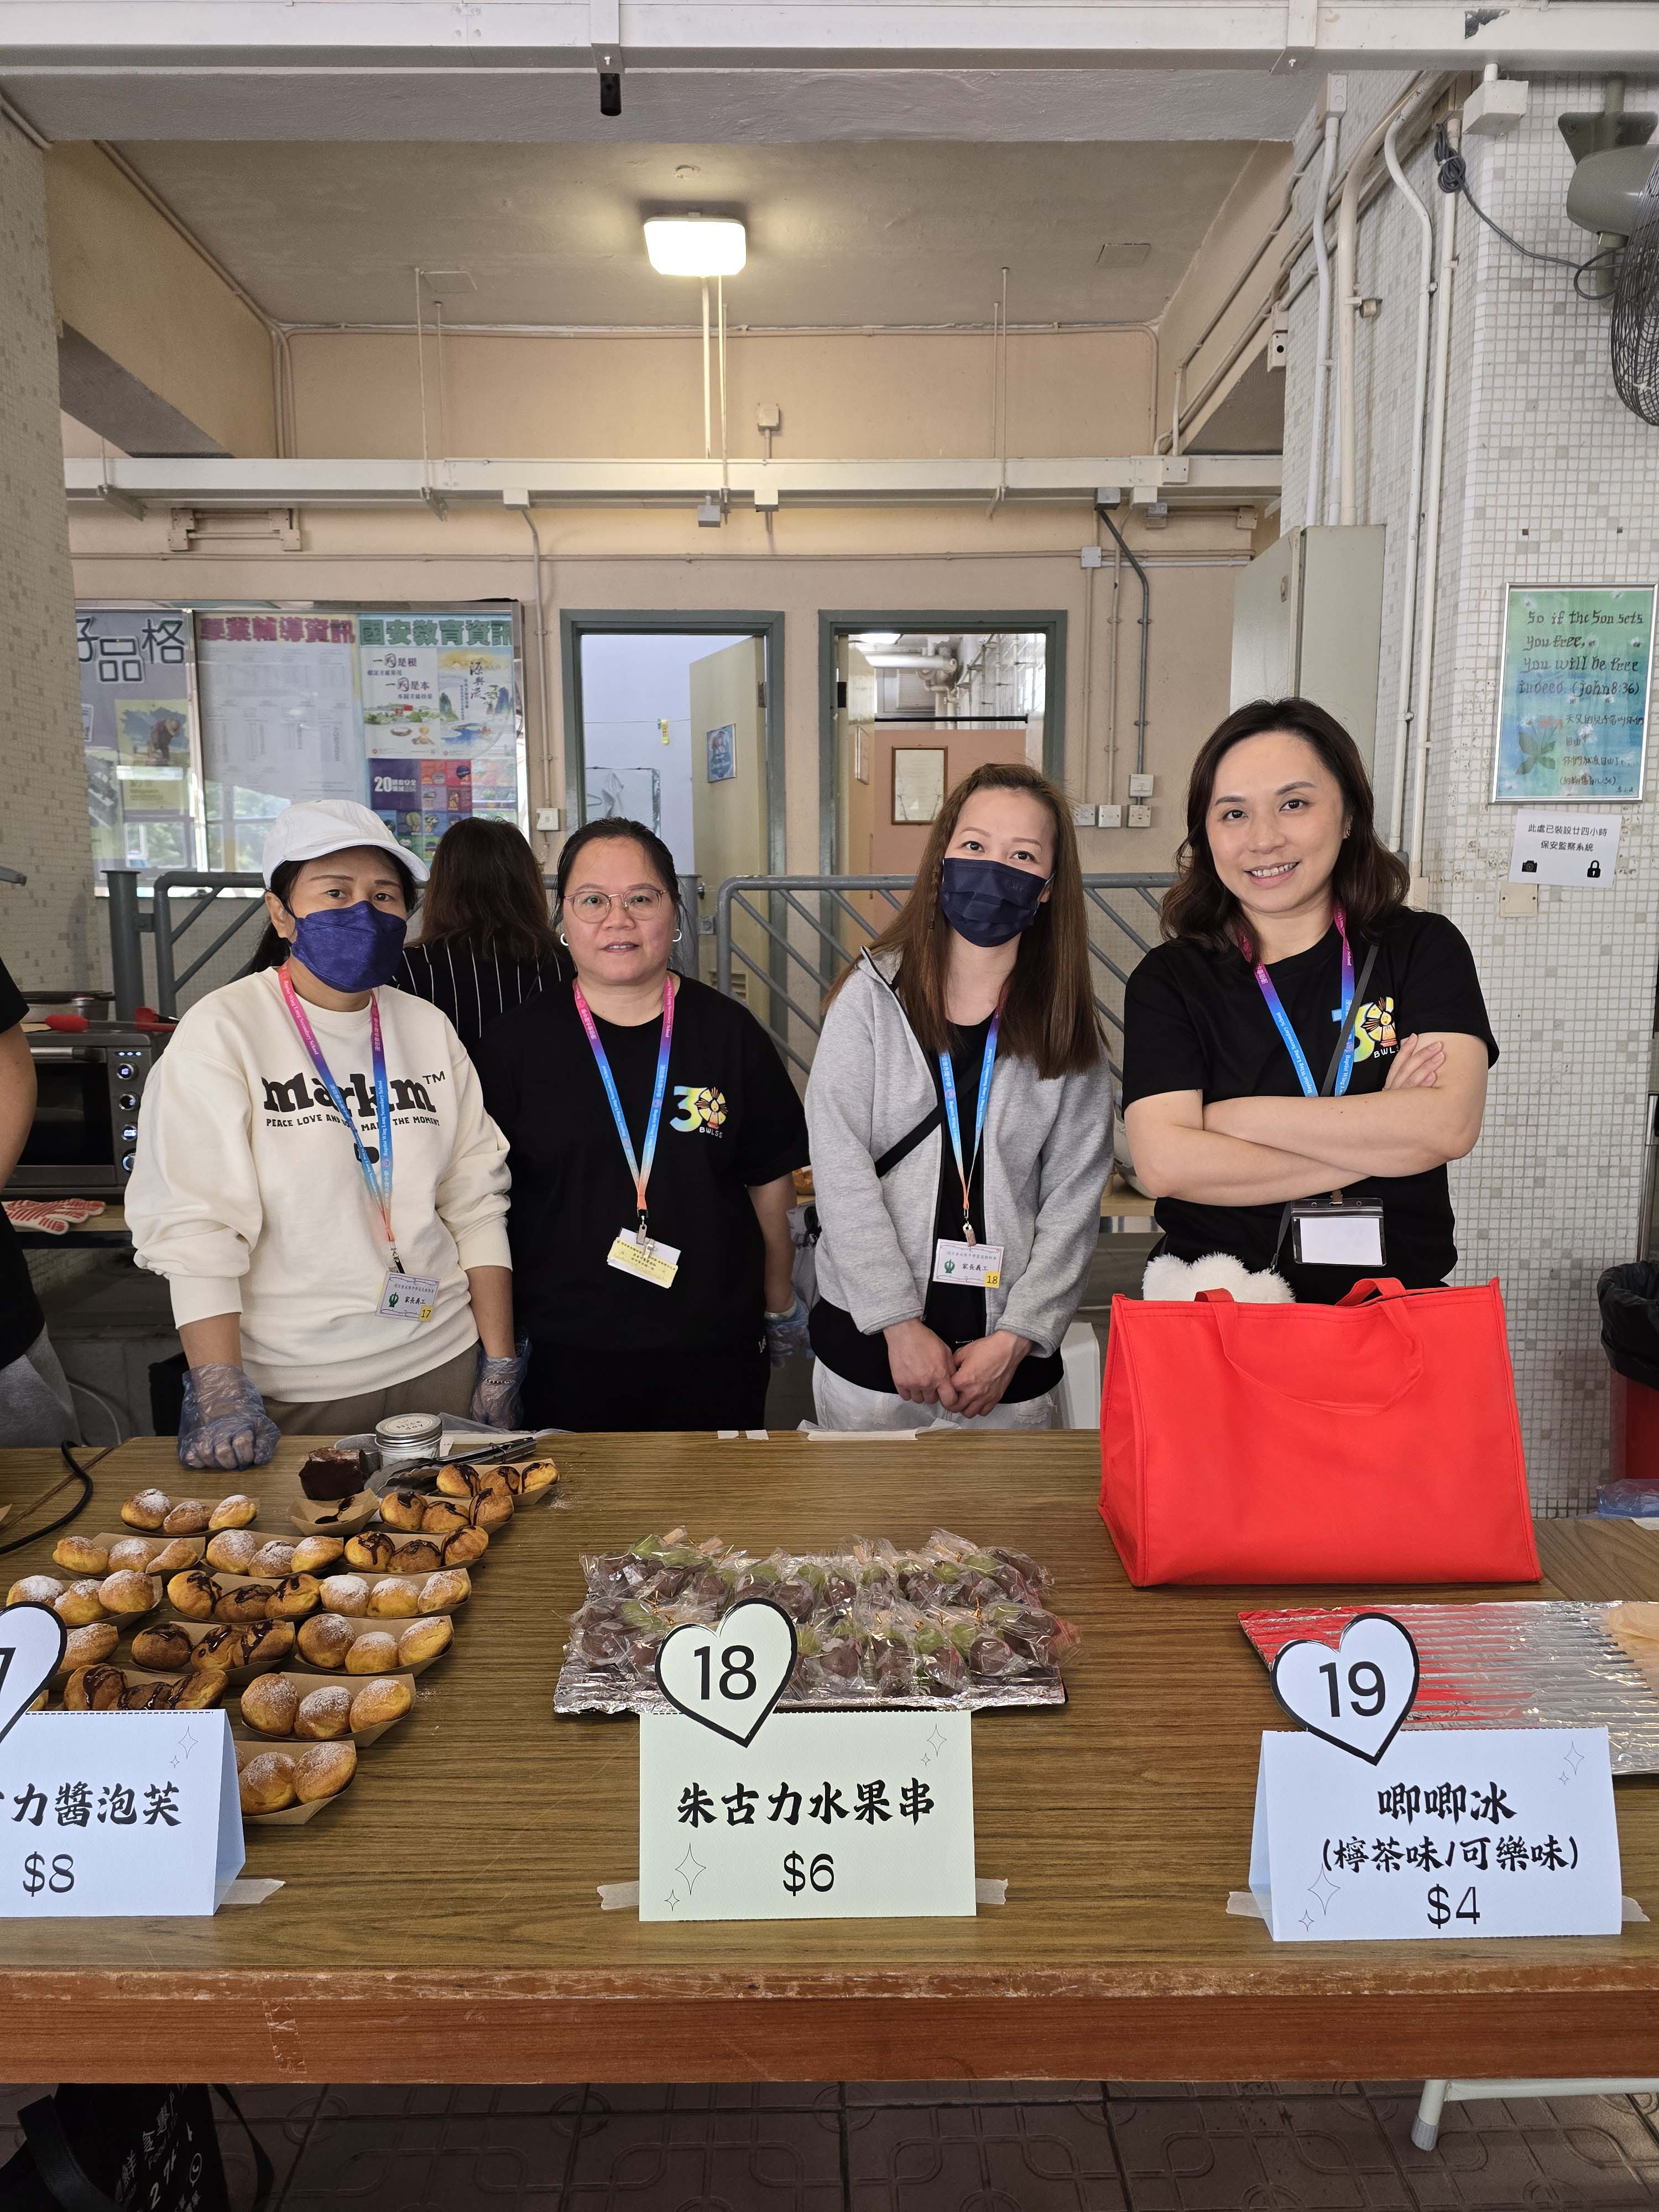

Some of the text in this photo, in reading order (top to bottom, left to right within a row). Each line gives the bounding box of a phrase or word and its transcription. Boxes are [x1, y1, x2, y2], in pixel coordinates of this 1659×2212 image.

[359, 619, 513, 646] 國安教育資訊
[1569, 610, 1589, 624] the
[1591, 609, 1614, 625] Son
[1555, 655, 1587, 670] will
[1592, 655, 1606, 671] be
[1528, 823, 1608, 837] 此處已裝設廿四小時
[1541, 840, 1594, 852] 保安監察系統
[266, 1118, 293, 1128] PEACE
[297, 1114, 322, 1126] LOVE
[326, 1115, 341, 1124] AND
[361, 1122, 379, 1132] MA
[393, 1117, 409, 1126] THE
[413, 1116, 440, 1127] MOMENT
[699, 1127, 723, 1139] BWLSS
[987, 1275, 998, 1284] 18
[421, 1309, 431, 1318] 17
[694, 1645, 757, 1700] 18
[1319, 1661, 1386, 1718] 19
[0, 1781, 182, 1827] 力醬泡芙
[677, 1777, 935, 1828] 朱古力水果串
[1378, 1782, 1517, 1825] 唧唧冰
[1322, 1835, 1578, 1872] (檸茶味/可樂味)
[23, 1851, 75, 1897] $8
[782, 1850, 834, 1896] $6
[1427, 1883, 1481, 1929] $4
